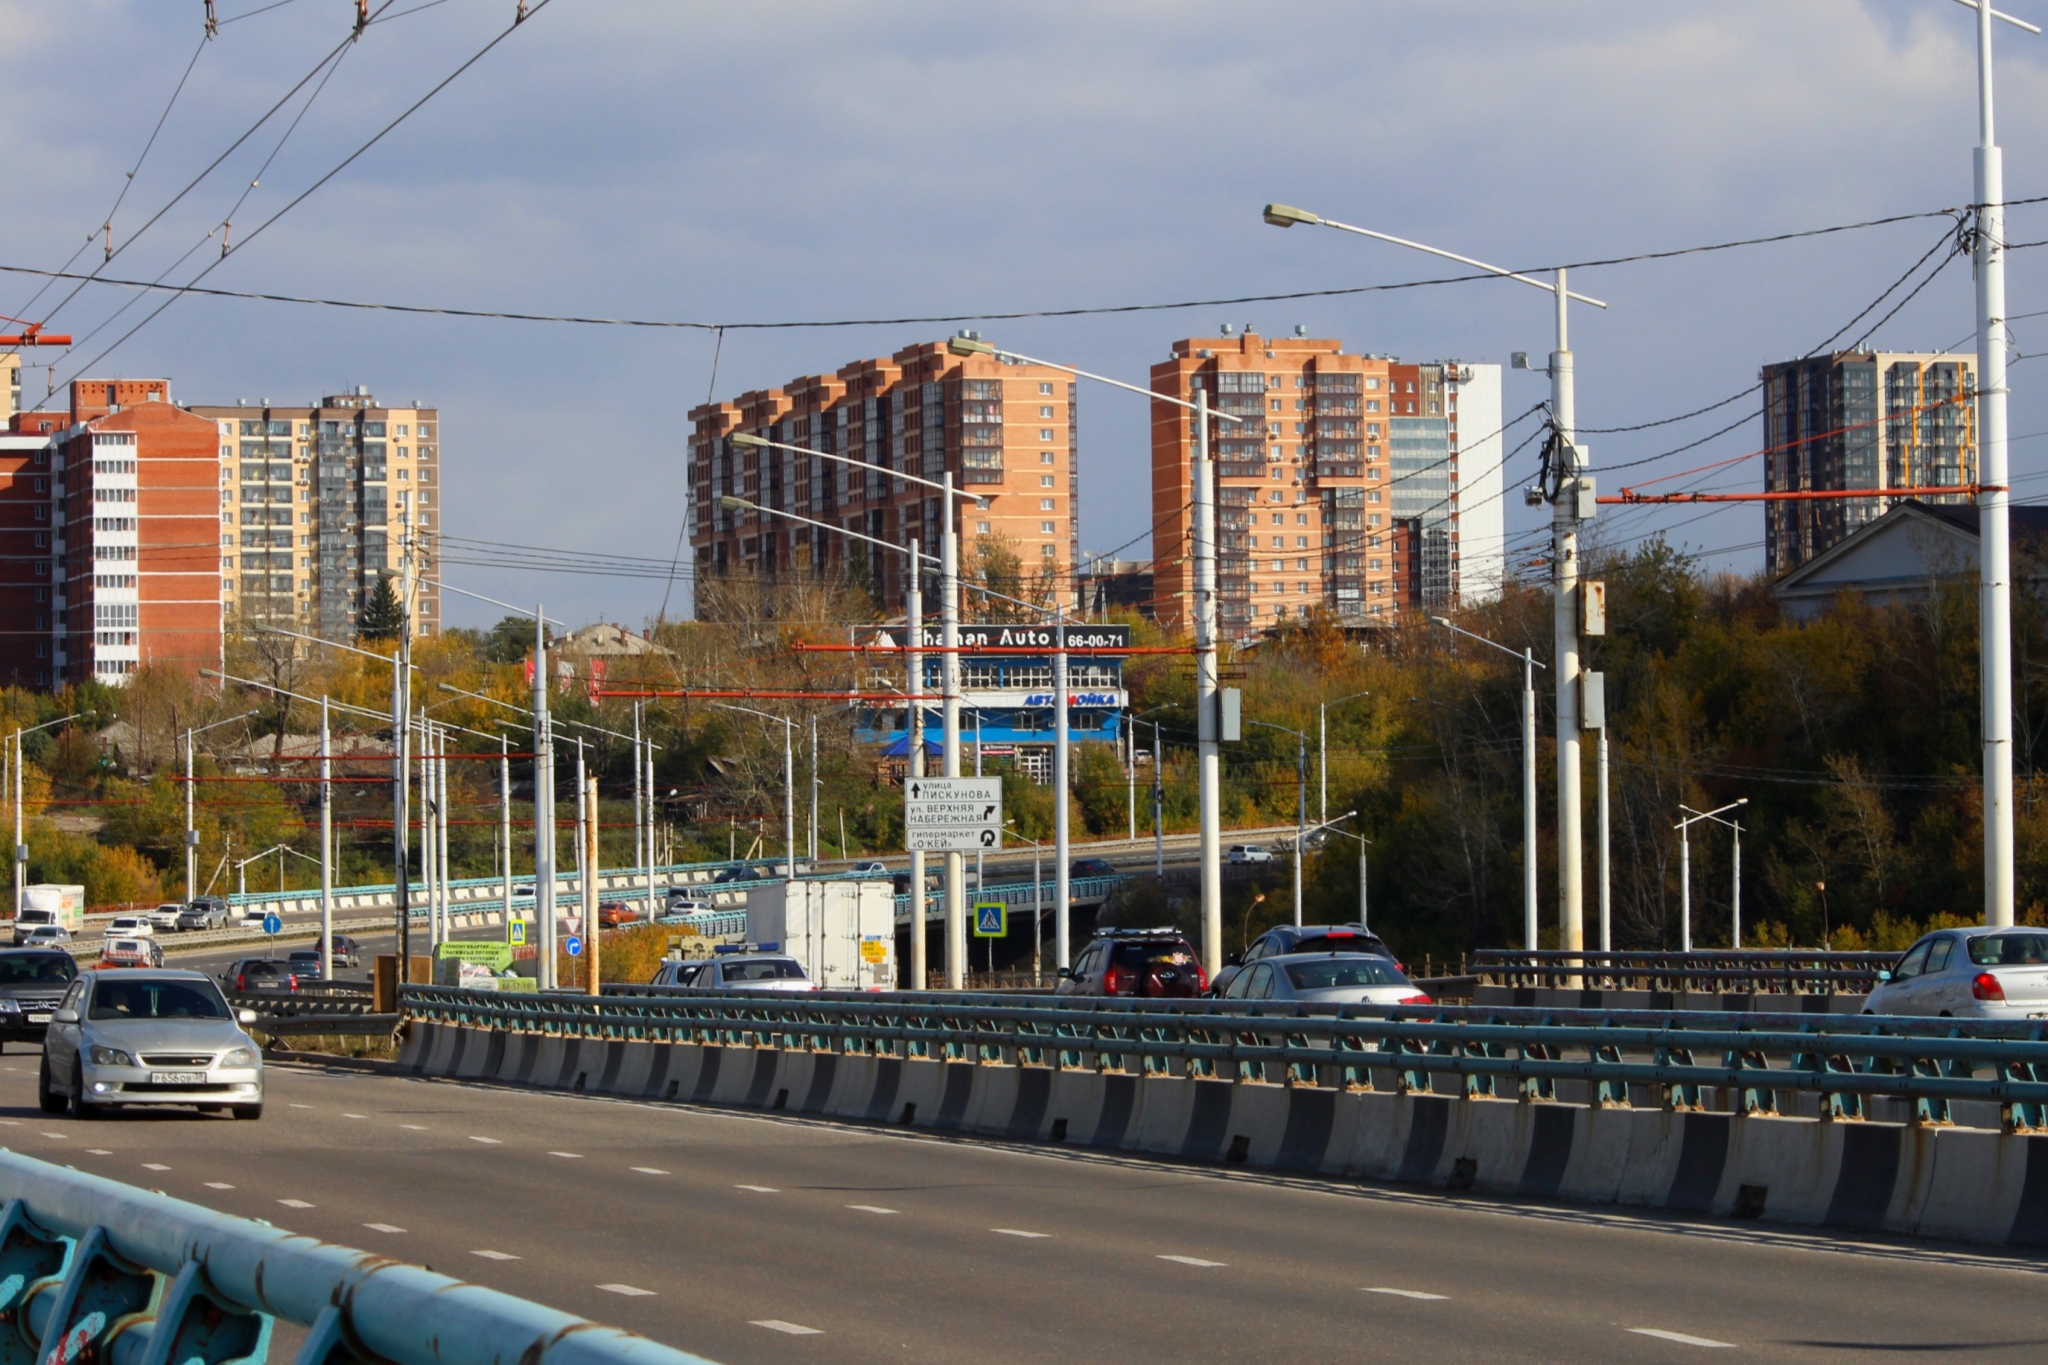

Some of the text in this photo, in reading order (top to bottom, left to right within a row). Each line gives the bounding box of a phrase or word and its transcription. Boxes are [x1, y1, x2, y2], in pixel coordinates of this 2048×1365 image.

[1000, 629, 1050, 646] Auto
[1067, 634, 1123, 647] 66-00-71
[1024, 692, 1115, 706] АВТМОЙКА
[923, 782, 952, 790] улица
[923, 791, 991, 799] ПИСКУНОВА
[910, 804, 974, 814] ул. ВЕРХНЯЯ
[910, 815, 982, 823] НАБЕРЕЖНАЯ
[912, 831, 975, 839] гипермаркет
